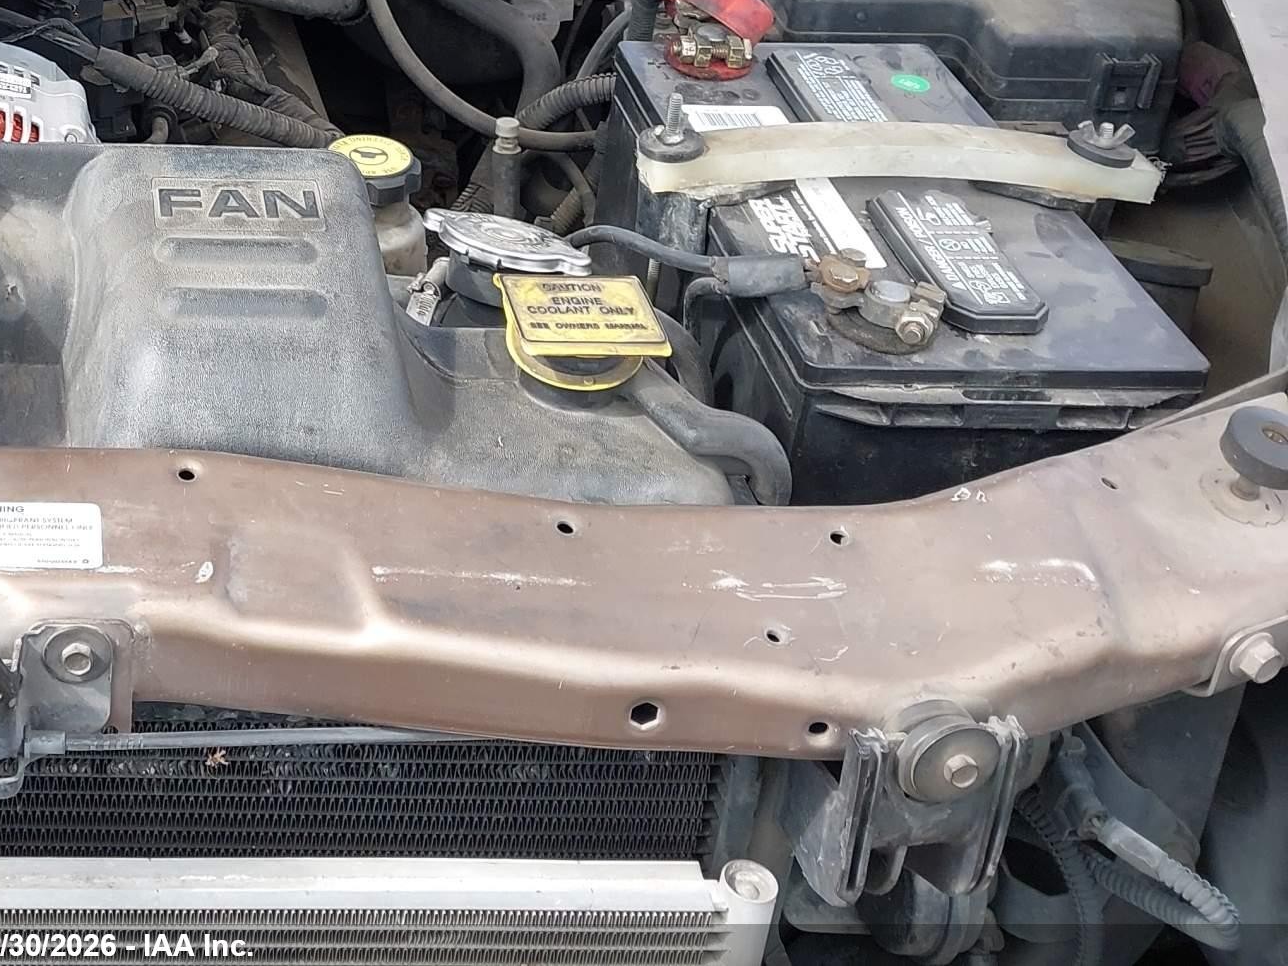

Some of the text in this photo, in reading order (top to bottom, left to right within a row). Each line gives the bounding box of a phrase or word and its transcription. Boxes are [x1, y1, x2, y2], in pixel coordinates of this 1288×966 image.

[158, 187, 320, 221] FAN
[542, 282, 602, 292] CAUTION
[551, 296, 604, 306] ENGINE
[527, 305, 635, 316] COOLANT ONLY
